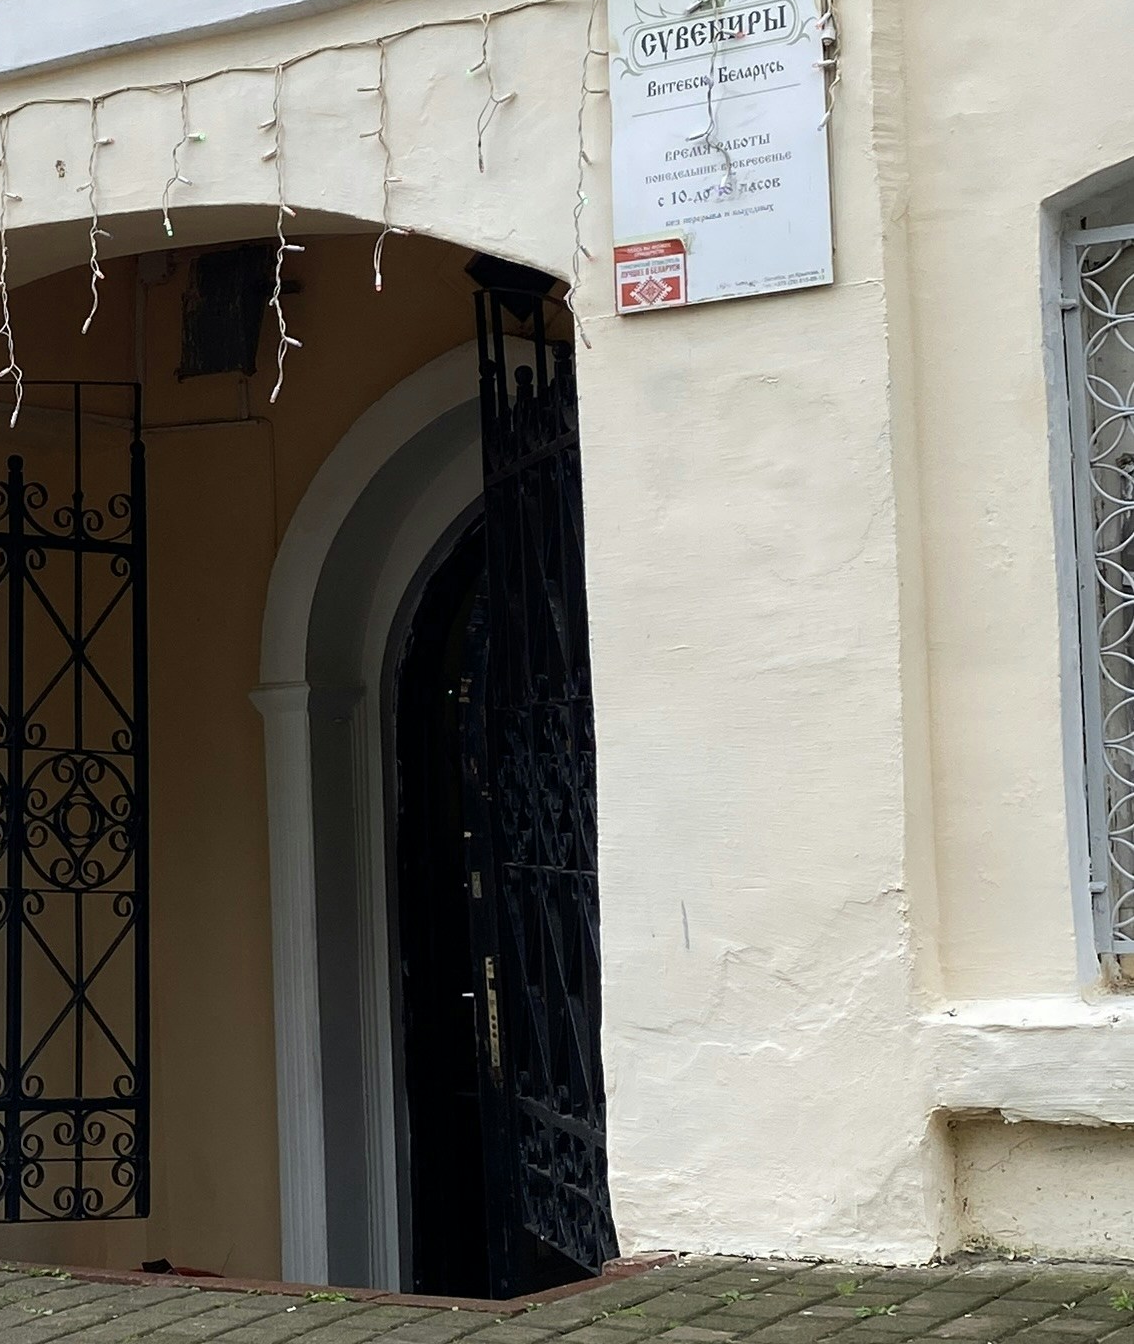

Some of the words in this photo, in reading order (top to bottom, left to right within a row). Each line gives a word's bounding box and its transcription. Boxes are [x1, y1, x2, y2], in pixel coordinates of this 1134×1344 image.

[641, 5, 787, 60] СУВЕНИРЫ
[718, 60, 784, 83] Беларусь
[665, 144, 711, 162] ВРЕМЯ
[716, 133, 770, 153] РАБОТЫ
